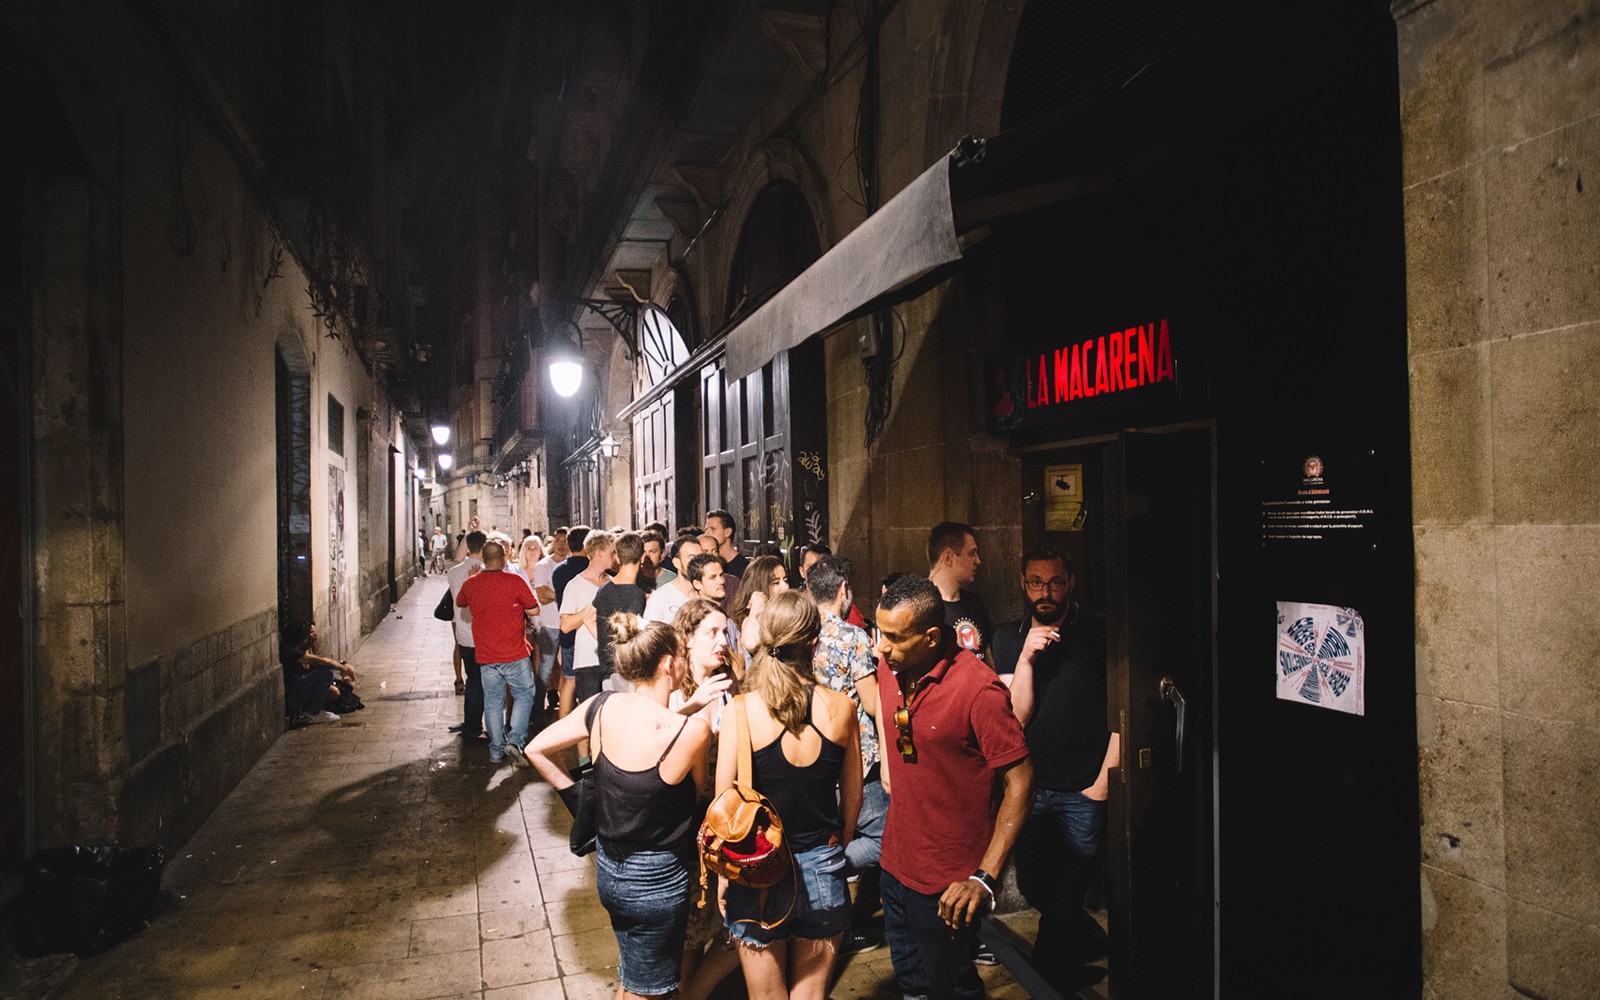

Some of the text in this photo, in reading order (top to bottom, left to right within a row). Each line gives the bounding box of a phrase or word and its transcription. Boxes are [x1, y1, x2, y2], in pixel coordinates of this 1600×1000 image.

[1026, 318, 1174, 409] LA MACARENA
[1287, 616, 1314, 646] SERIES
[1326, 669, 1351, 698] HEROES
